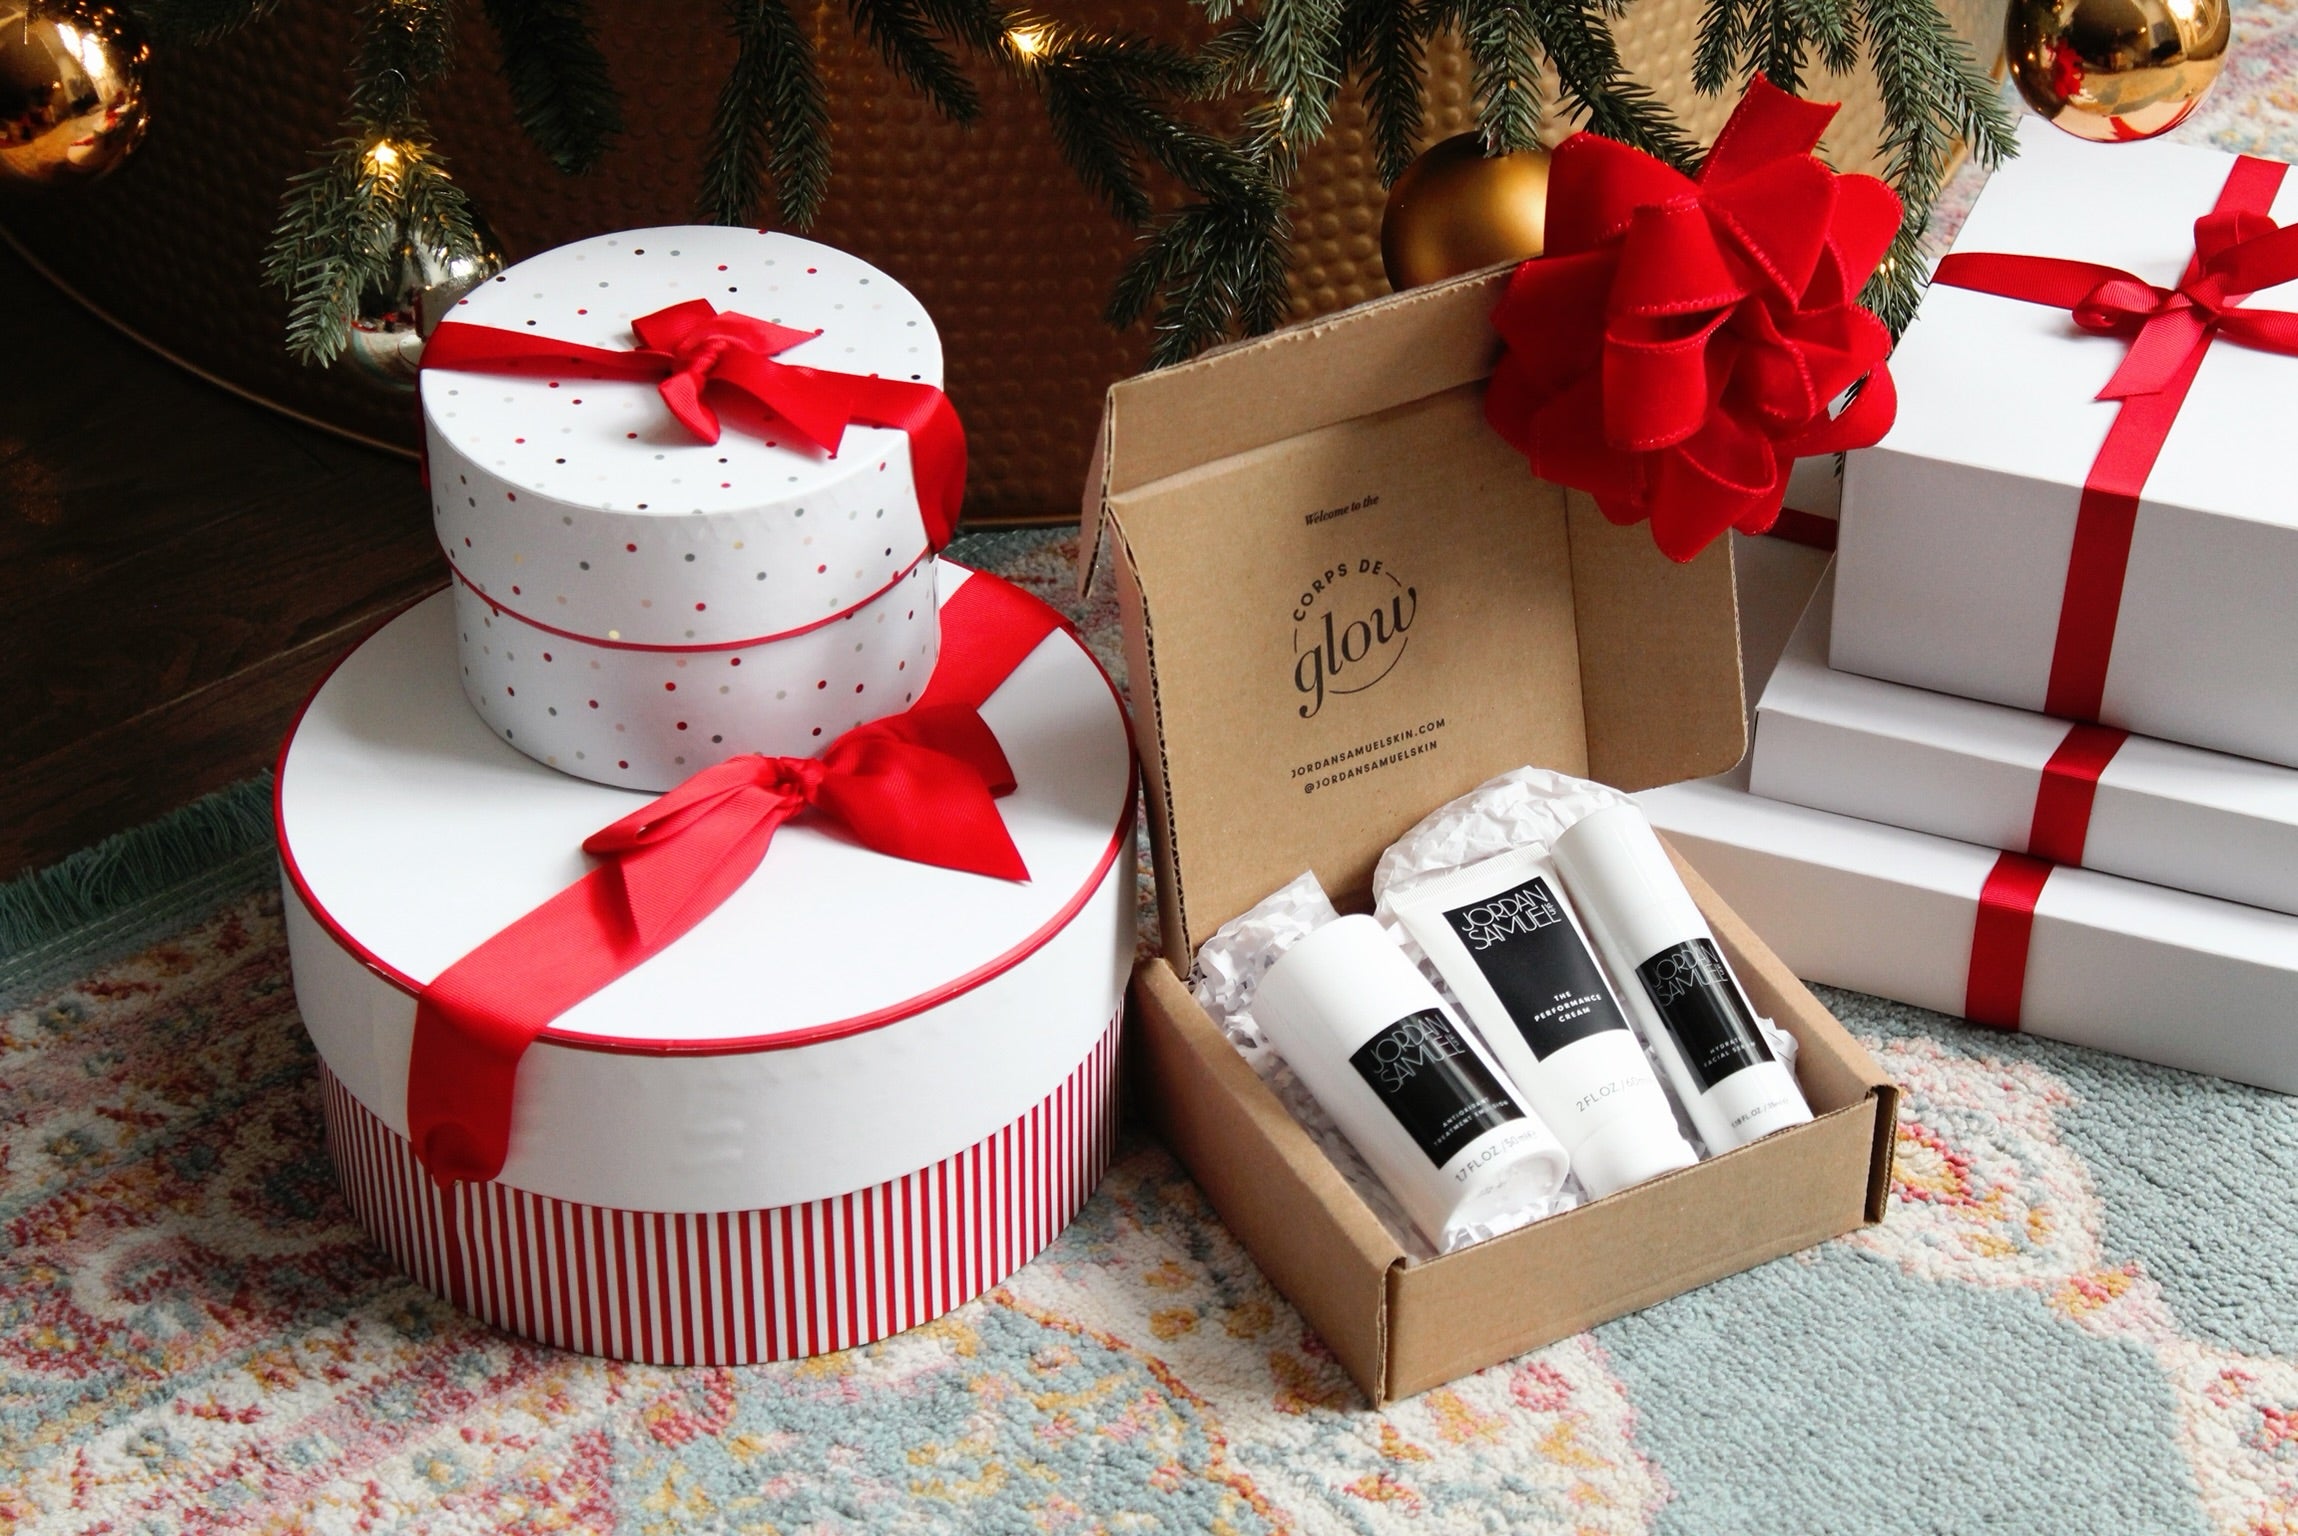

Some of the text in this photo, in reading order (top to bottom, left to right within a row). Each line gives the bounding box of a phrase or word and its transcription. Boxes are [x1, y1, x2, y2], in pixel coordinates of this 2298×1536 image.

[1305, 495, 1379, 526] Welcome to the
[1293, 559, 1383, 622] CORPS DE
[1294, 587, 1417, 719] glow
[1291, 718, 1446, 778] JORDANSAMUELSKIN.COM
[1304, 740, 1437, 794] @JORDANSAMUELSKIN
[1461, 884, 1549, 932] JORDAN
[1468, 904, 1561, 950] SAMUEL
[1653, 945, 1718, 988] JORDAN
[1656, 963, 1728, 1007] SAMUEL
[1534, 994, 1602, 1022] PERFORMANCE
[1553, 991, 1571, 1002] THE
[1558, 1007, 1591, 1023] CREAM
[1370, 1014, 1450, 1074] JORDAN
[1380, 1035, 1465, 1093] SAMUEL
[1704, 1041, 1756, 1068] FACIAL SERM
[1433, 1100, 1509, 1146] TREATMENT EMSION
